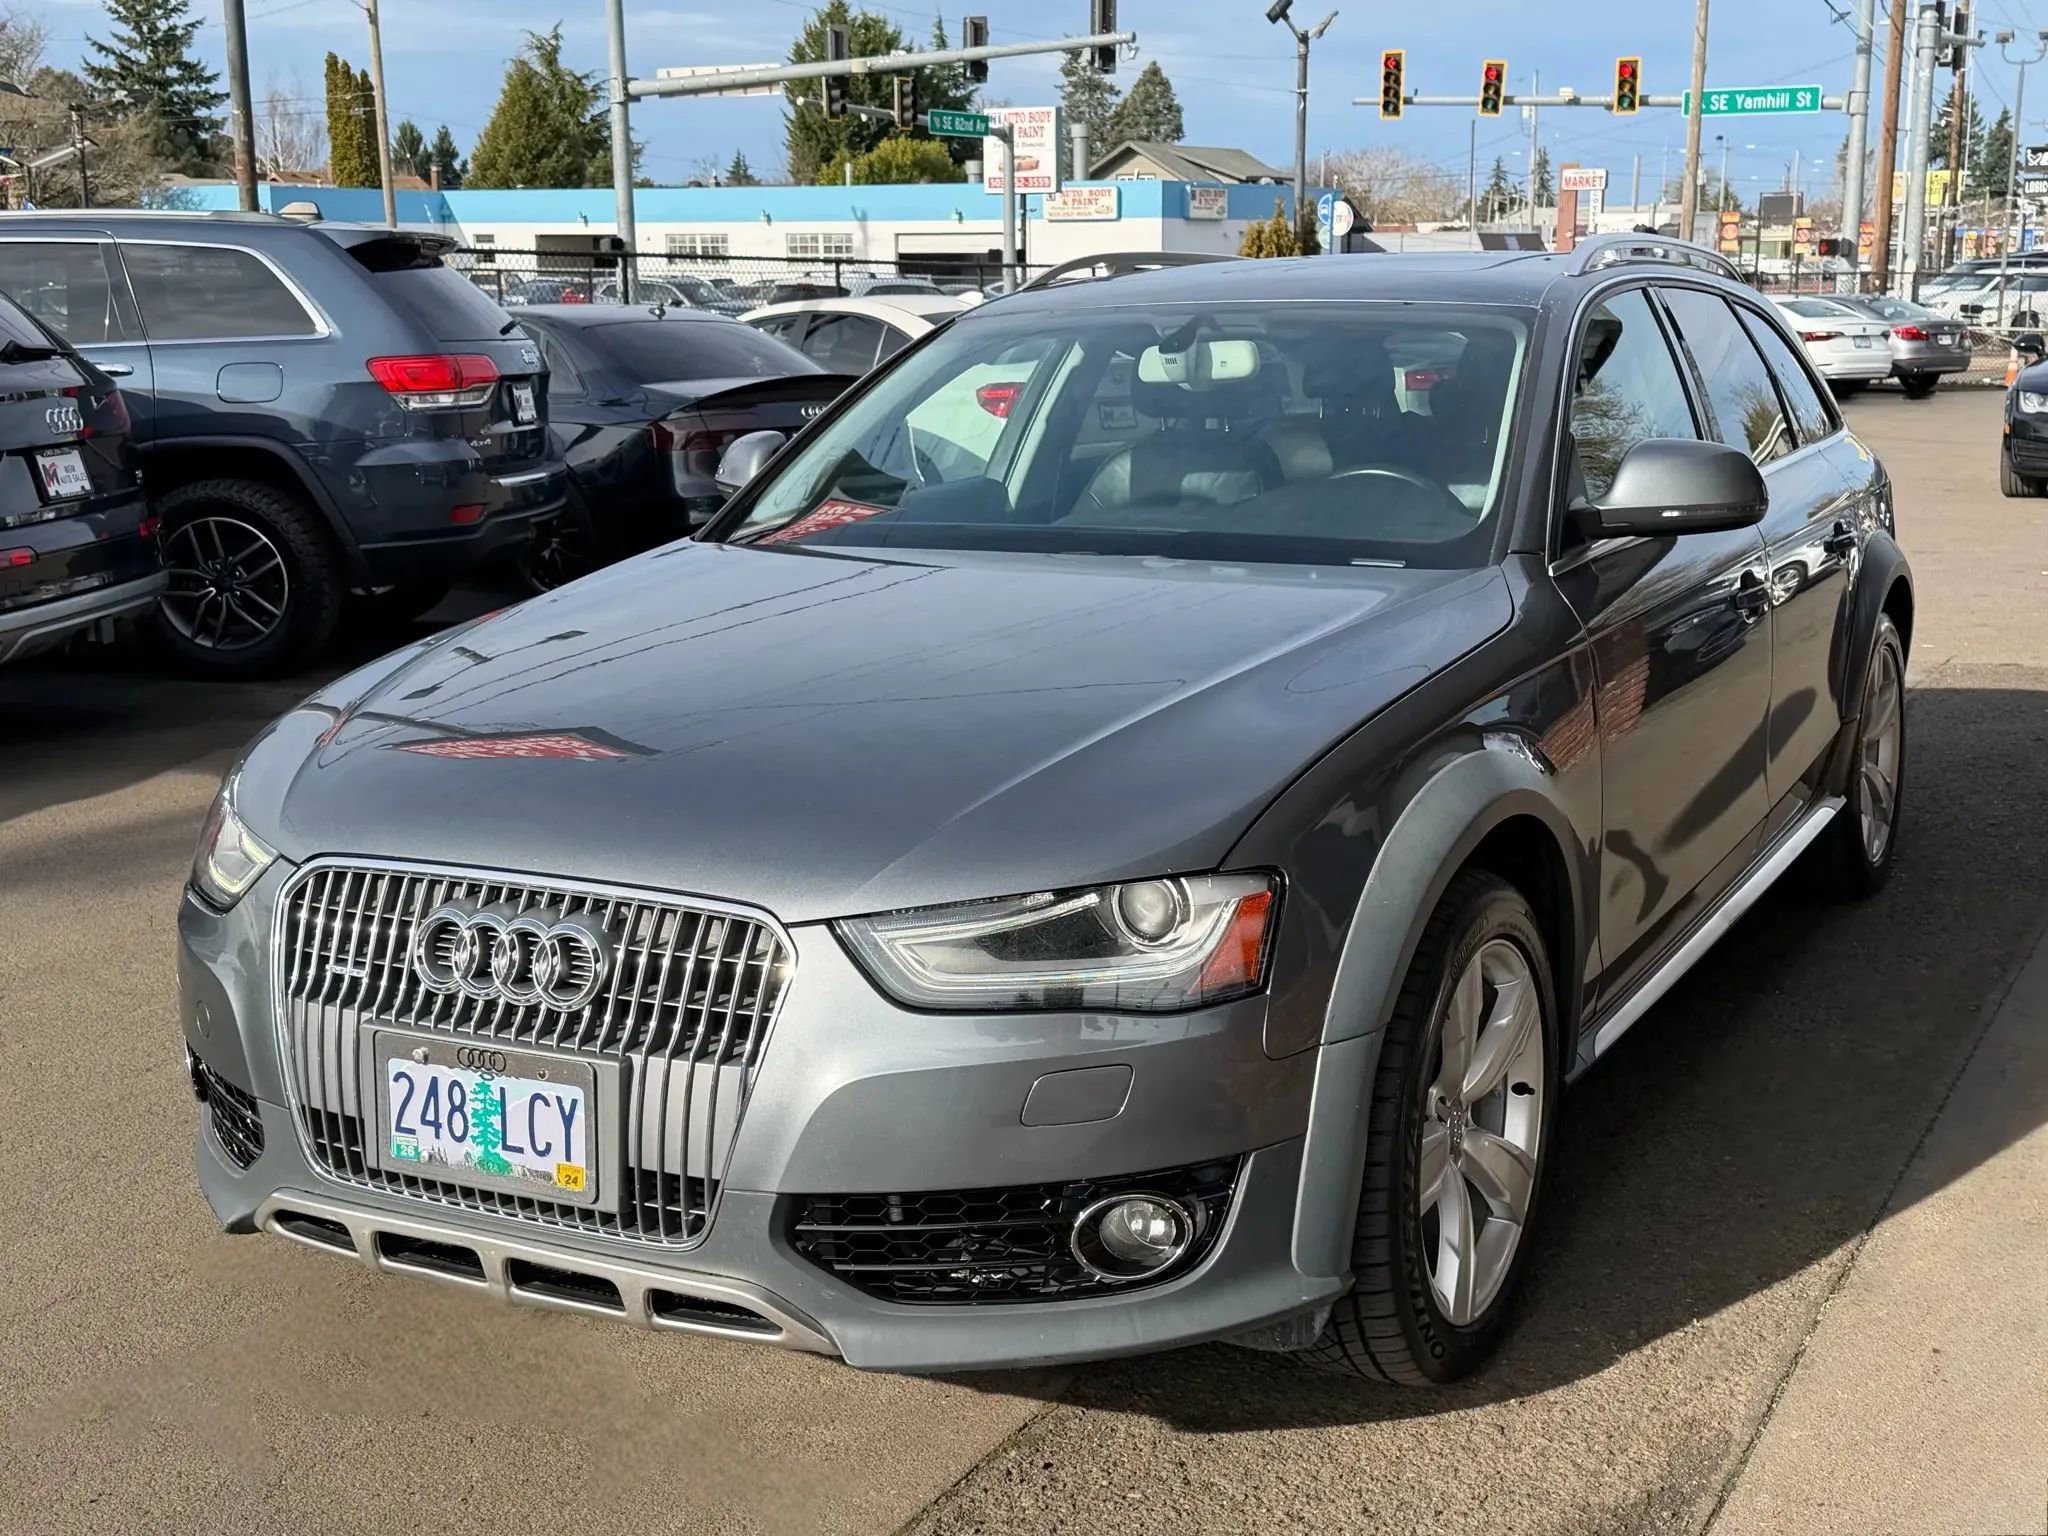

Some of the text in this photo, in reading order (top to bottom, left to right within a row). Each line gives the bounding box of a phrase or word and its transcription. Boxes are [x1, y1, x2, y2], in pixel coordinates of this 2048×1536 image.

[1710, 91, 1812, 110] SE Yamhill St
[1004, 111, 1026, 124] AUTO
[1028, 111, 1051, 123] BODY
[943, 116, 985, 132] SE 82nd Av
[1018, 126, 1045, 138] PAINT
[1564, 176, 1604, 188] MARKET
[1088, 189, 1112, 197] BODY
[1072, 198, 1099, 206] PAINT
[393, 1071, 578, 1163] 248 LCY
[400, 1145, 414, 1157] 26
[564, 1174, 578, 1187] 24
